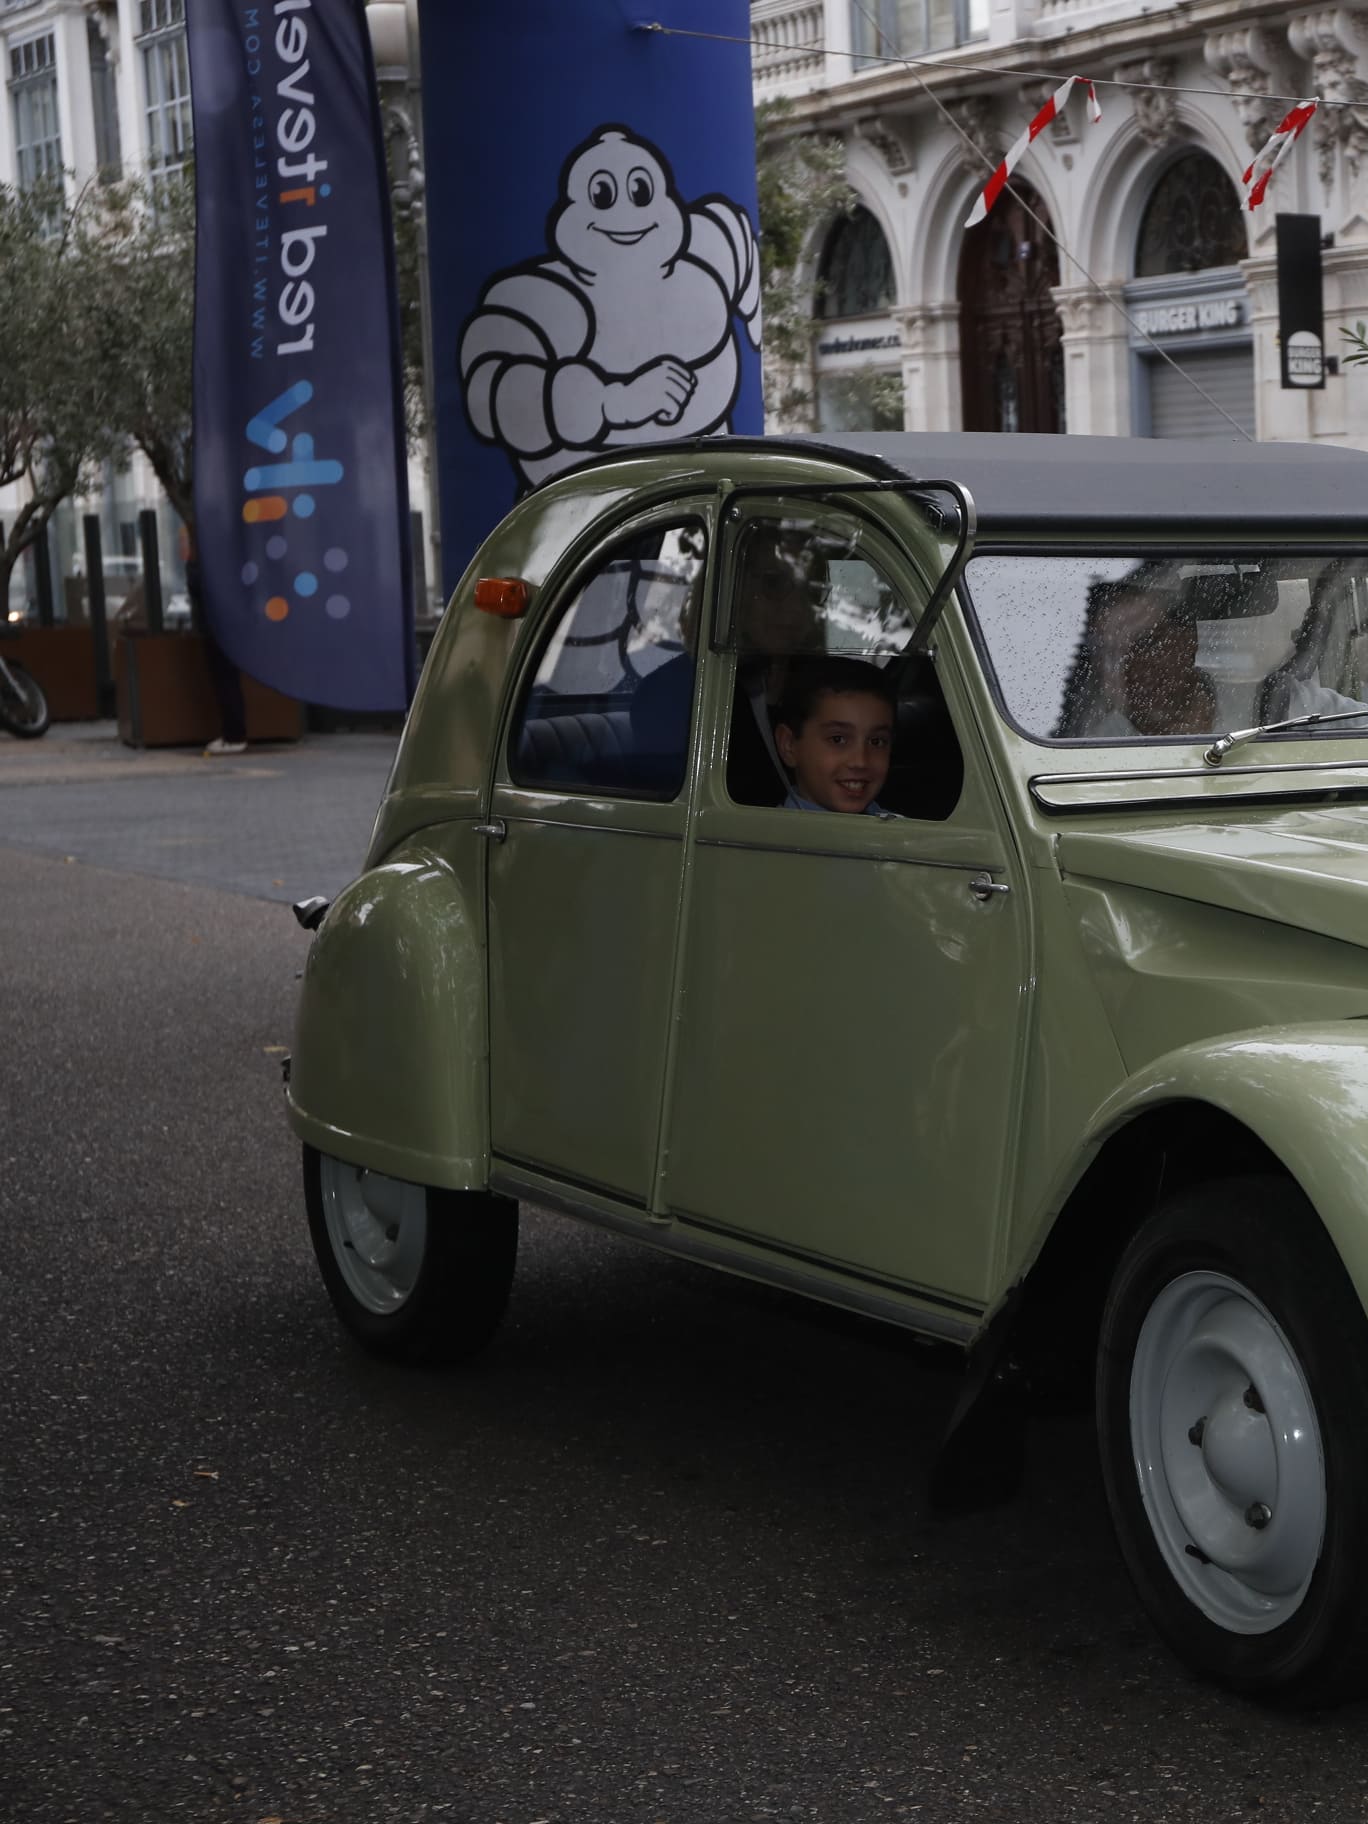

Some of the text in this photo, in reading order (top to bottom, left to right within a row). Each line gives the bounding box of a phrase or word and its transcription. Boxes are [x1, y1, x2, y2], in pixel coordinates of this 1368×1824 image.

[1135, 301, 1238, 335] BURGER KING
[1288, 358, 1322, 373] KING
